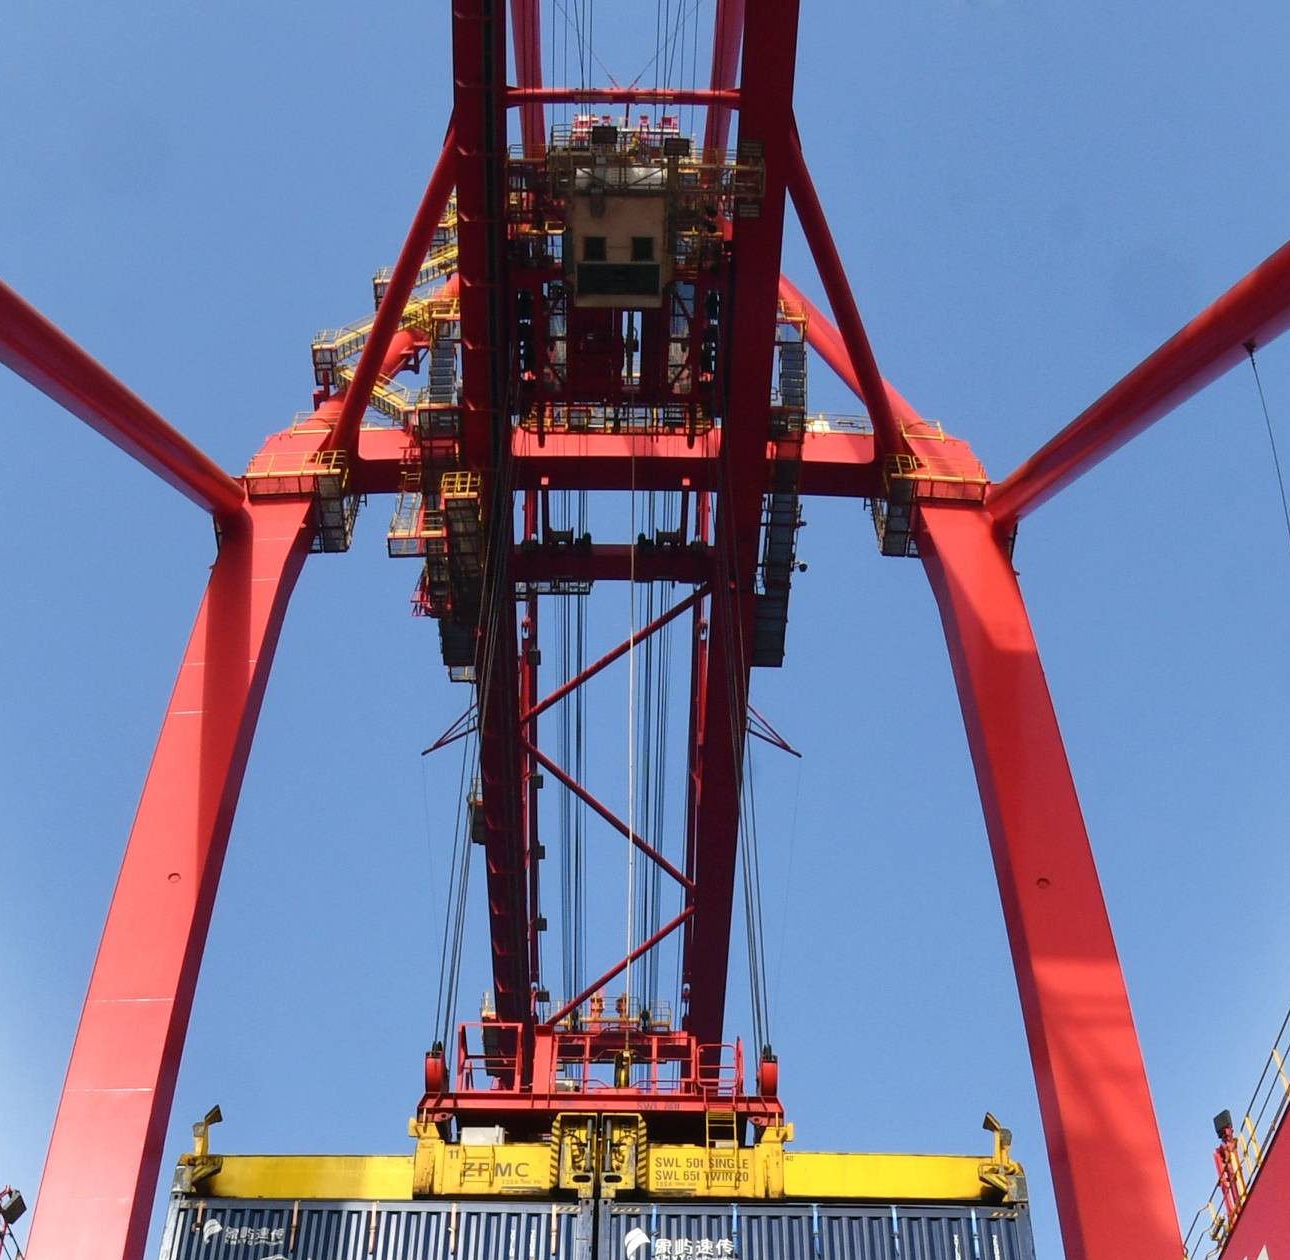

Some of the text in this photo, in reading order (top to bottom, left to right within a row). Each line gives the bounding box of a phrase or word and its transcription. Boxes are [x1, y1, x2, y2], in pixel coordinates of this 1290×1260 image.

[462, 1162, 530, 1178] ZPMC
[655, 1156, 682, 1168] SWL
[708, 1158, 749, 1170] SINGLE
[655, 1169, 680, 1181] SWL
